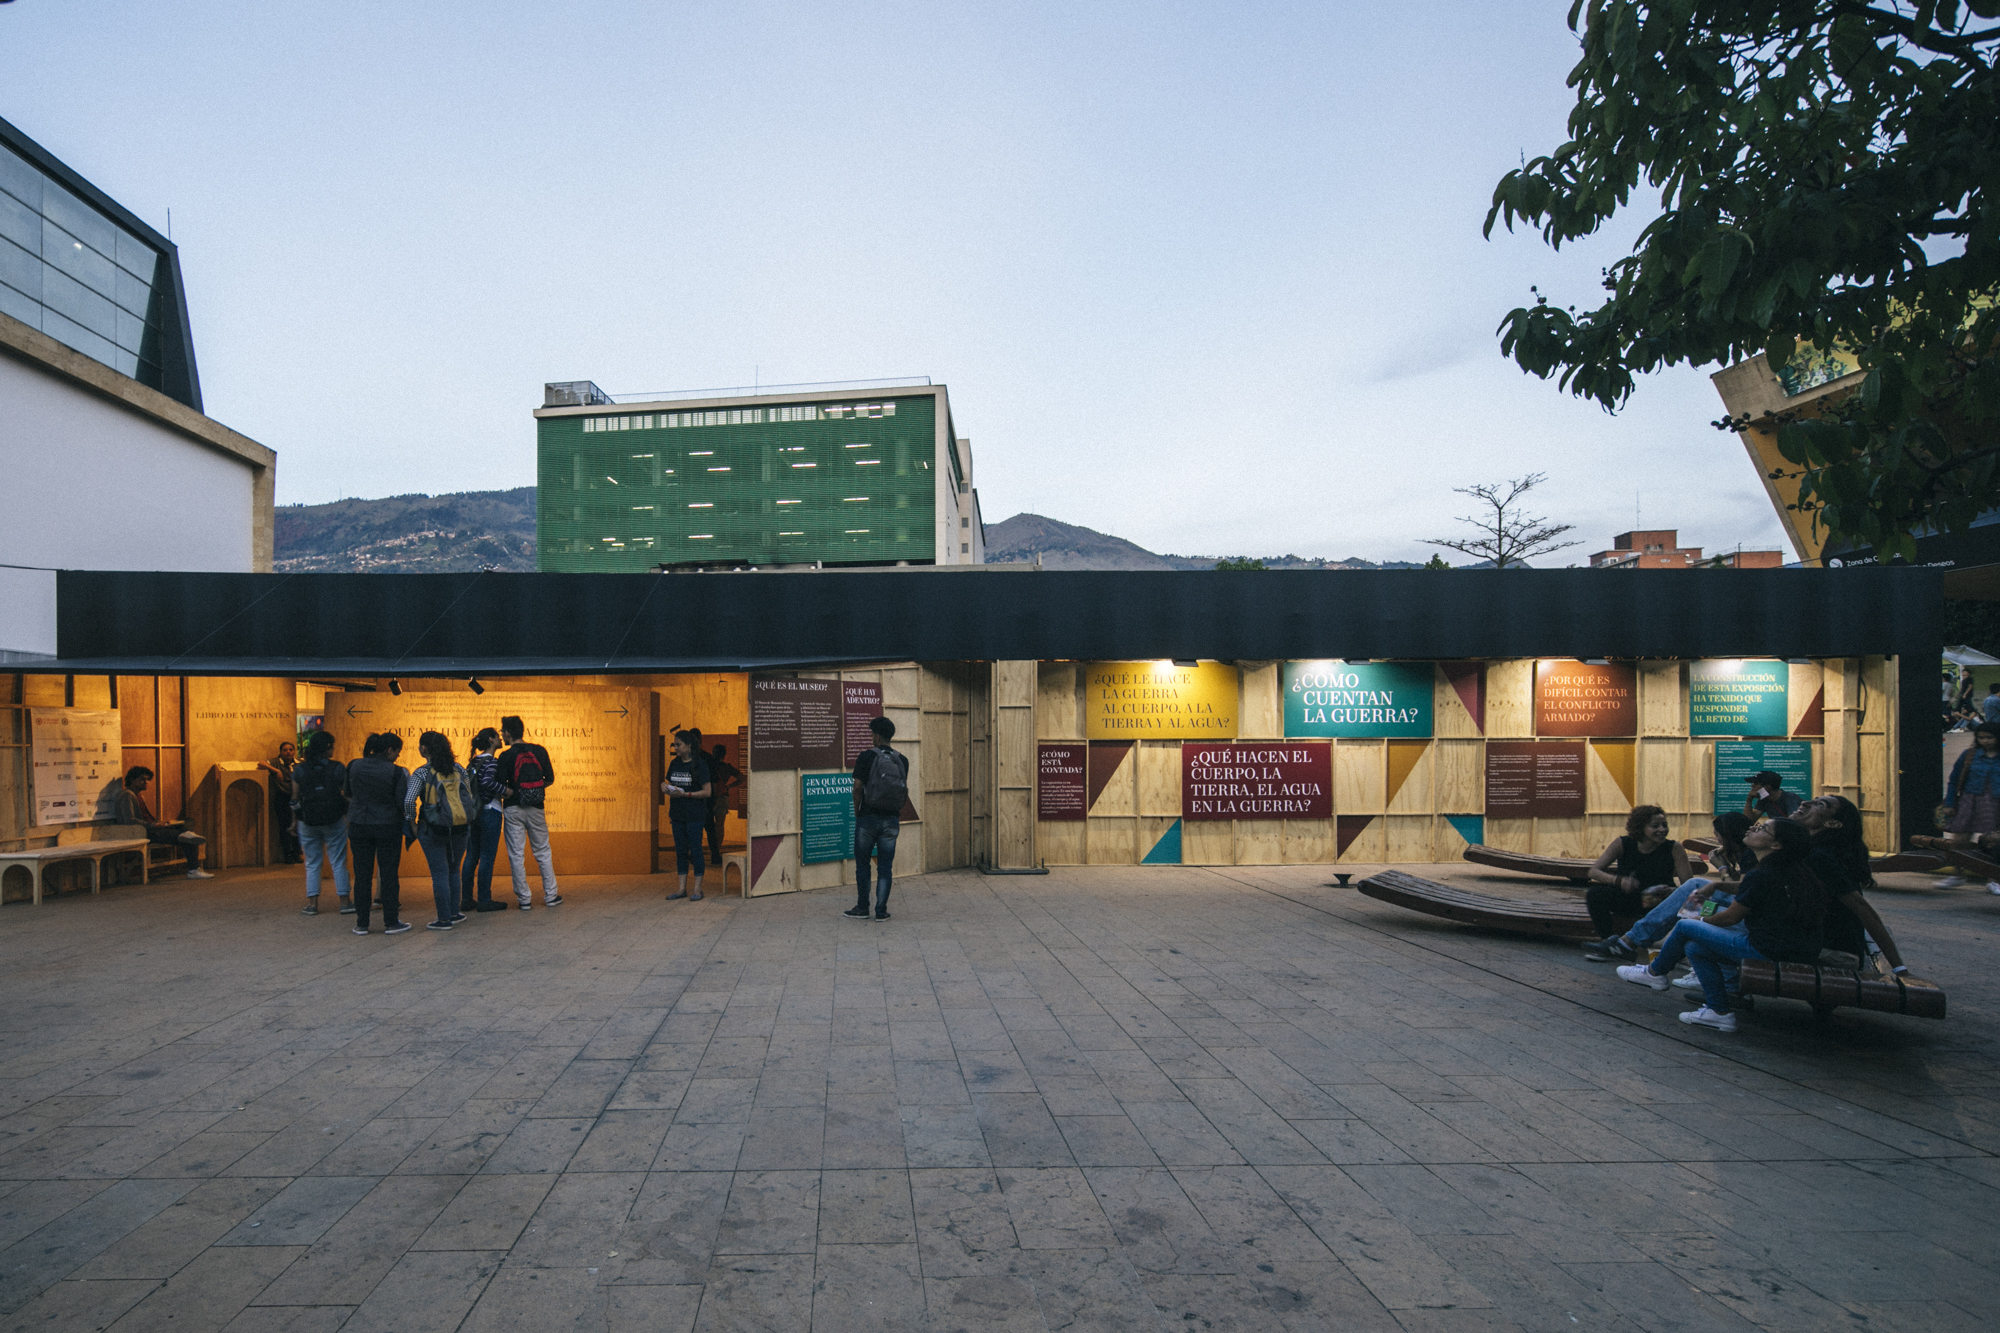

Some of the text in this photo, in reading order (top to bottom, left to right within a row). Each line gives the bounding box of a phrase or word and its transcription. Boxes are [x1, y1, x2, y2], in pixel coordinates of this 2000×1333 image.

[1095, 672, 1191, 687] ¿QUÉ LE HACE
[1544, 674, 1610, 687] ¿POR QUÉ ES
[1706, 673, 1776, 682] CONSTRUCCIÓN
[755, 681, 776, 690] ¿QUÉ
[777, 682, 787, 690] ES
[799, 683, 828, 691] MUSEO?
[1732, 683, 1785, 692] EXPOSICIÓN
[845, 687, 863, 697] ¿QUÉ
[1102, 689, 1178, 699] LA GUERRA
[1544, 687, 1628, 697] DIFÍCIL CONTAR
[846, 697, 880, 705] ADENTRO?
[1303, 691, 1394, 706] CUENTAN
[1744, 695, 1762, 704] QUE
[1102, 703, 1119, 714] AL
[1184, 703, 1193, 714] A
[1196, 703, 1213, 714] LA
[1544, 701, 1620, 709] EL CONFLICTO
[1303, 708, 1418, 723] LA GUERRA?
[1544, 713, 1596, 721] ARMADO?
[1102, 718, 1230, 728] TIERRA Y AL AGUA?
[534, 727, 593, 737] GUERRA?
[1041, 750, 1070, 758] ¿CÓMO
[1191, 748, 1312, 767] ¿QUÉ HACEN EL
[1041, 758, 1062, 766] ESTÁ
[1191, 767, 1282, 781] CUERPO, LA
[806, 778, 820, 786] ¿EN
[821, 776, 837, 787] QUÉ
[806, 787, 825, 795] ESTA
[1191, 783, 1322, 798] TIERRA, EL AGUA
[1191, 799, 1311, 813] EN LA GUERRA?
